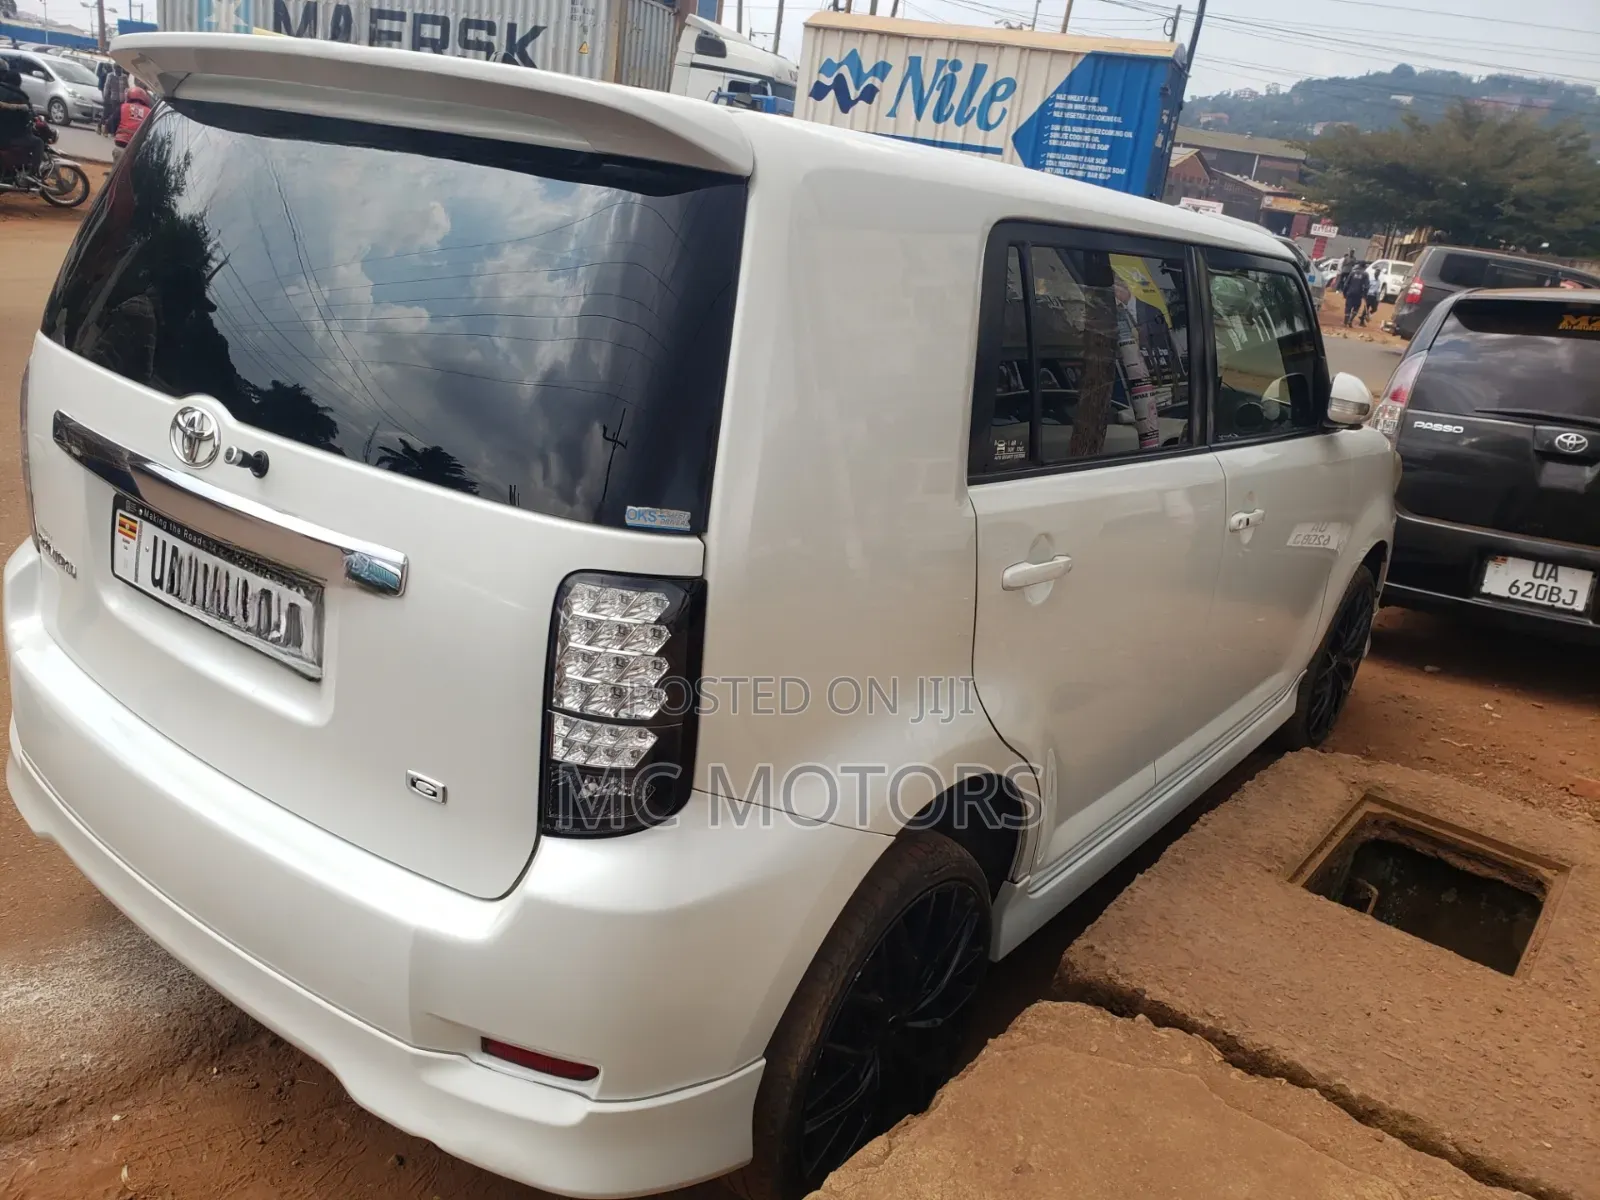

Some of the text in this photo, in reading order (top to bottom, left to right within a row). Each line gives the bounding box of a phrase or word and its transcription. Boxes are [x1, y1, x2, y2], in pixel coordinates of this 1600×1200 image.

[272, 0, 548, 69] MAERSK
[886, 54, 1018, 132] Nile
[1414, 420, 1464, 434] PASSO
[143, 508, 168, 530] Making
[169, 522, 181, 533] the
[1532, 561, 1559, 583] UA
[1508, 579, 1578, 606] 620BJ
